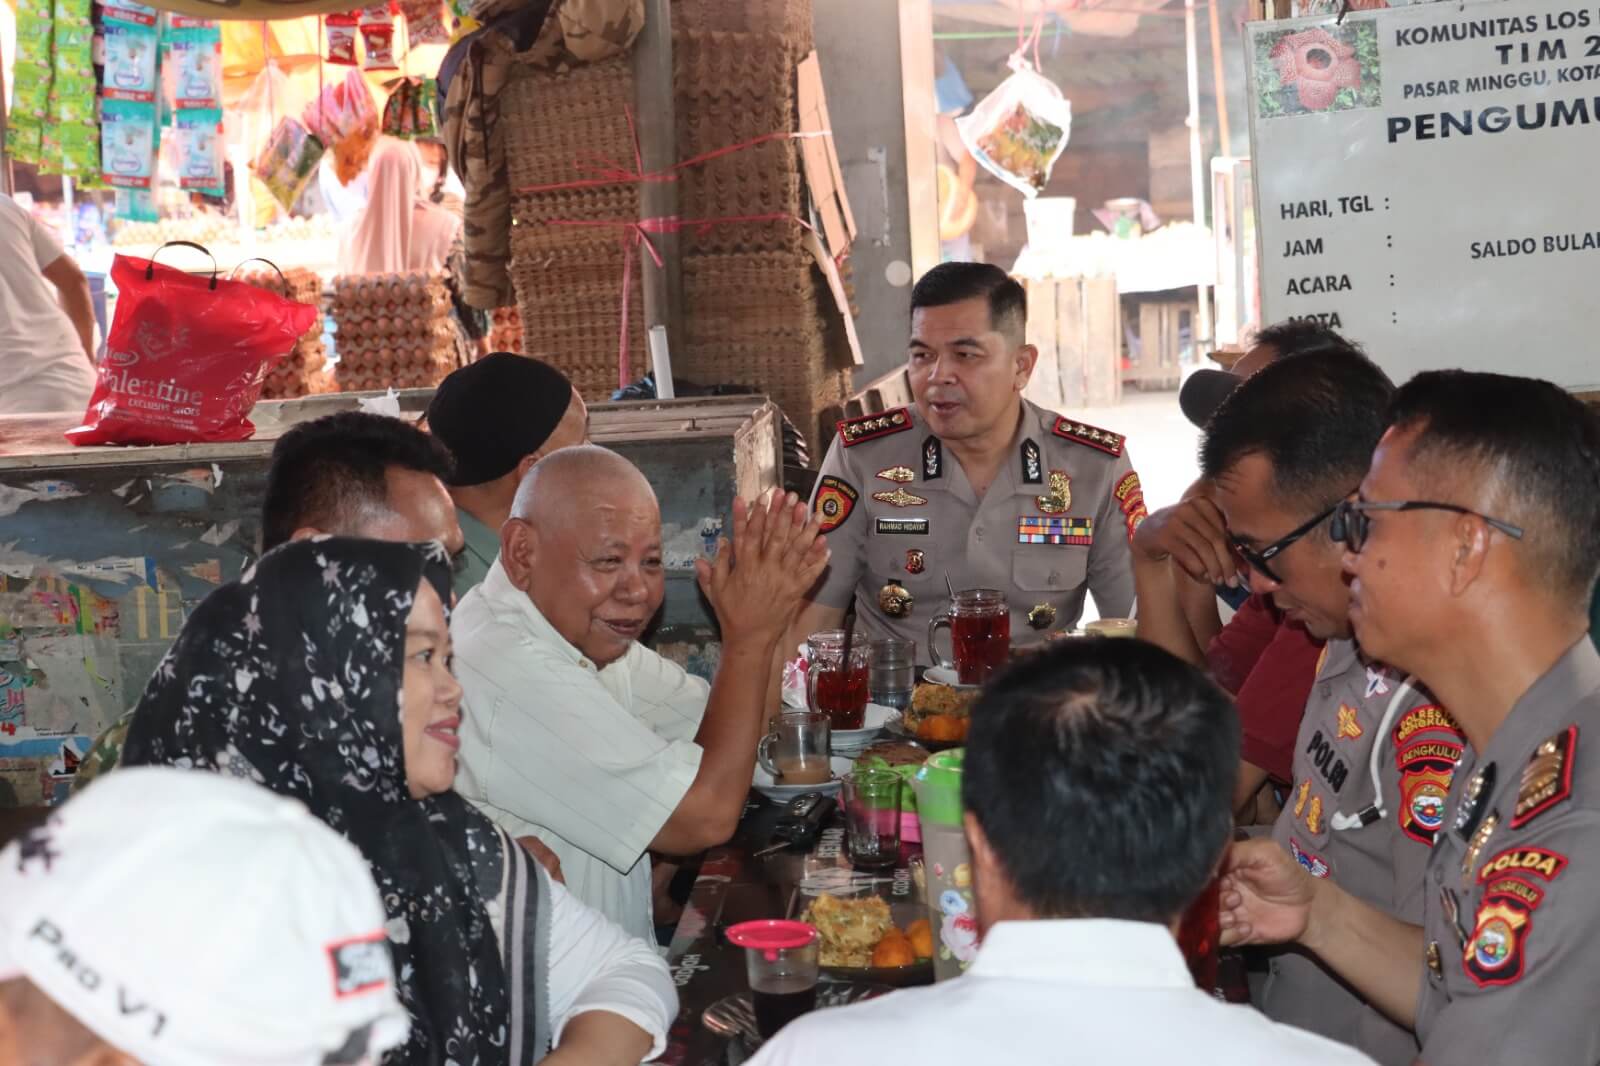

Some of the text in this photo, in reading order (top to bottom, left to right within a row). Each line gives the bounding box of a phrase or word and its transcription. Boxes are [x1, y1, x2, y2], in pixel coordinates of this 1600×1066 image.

[1395, 9, 1591, 47] KOMUNITAS LOS
[1495, 38, 1567, 65] TIM
[1403, 64, 1600, 99] PASAR MINGGU, KOTA
[1387, 96, 1600, 144] PENGUM
[1280, 199, 1333, 220] HARI,
[1338, 195, 1374, 214] TGL
[1283, 237, 1324, 258] JAM
[1470, 231, 1600, 260] SALDO BULA
[1286, 274, 1352, 295] ACARA
